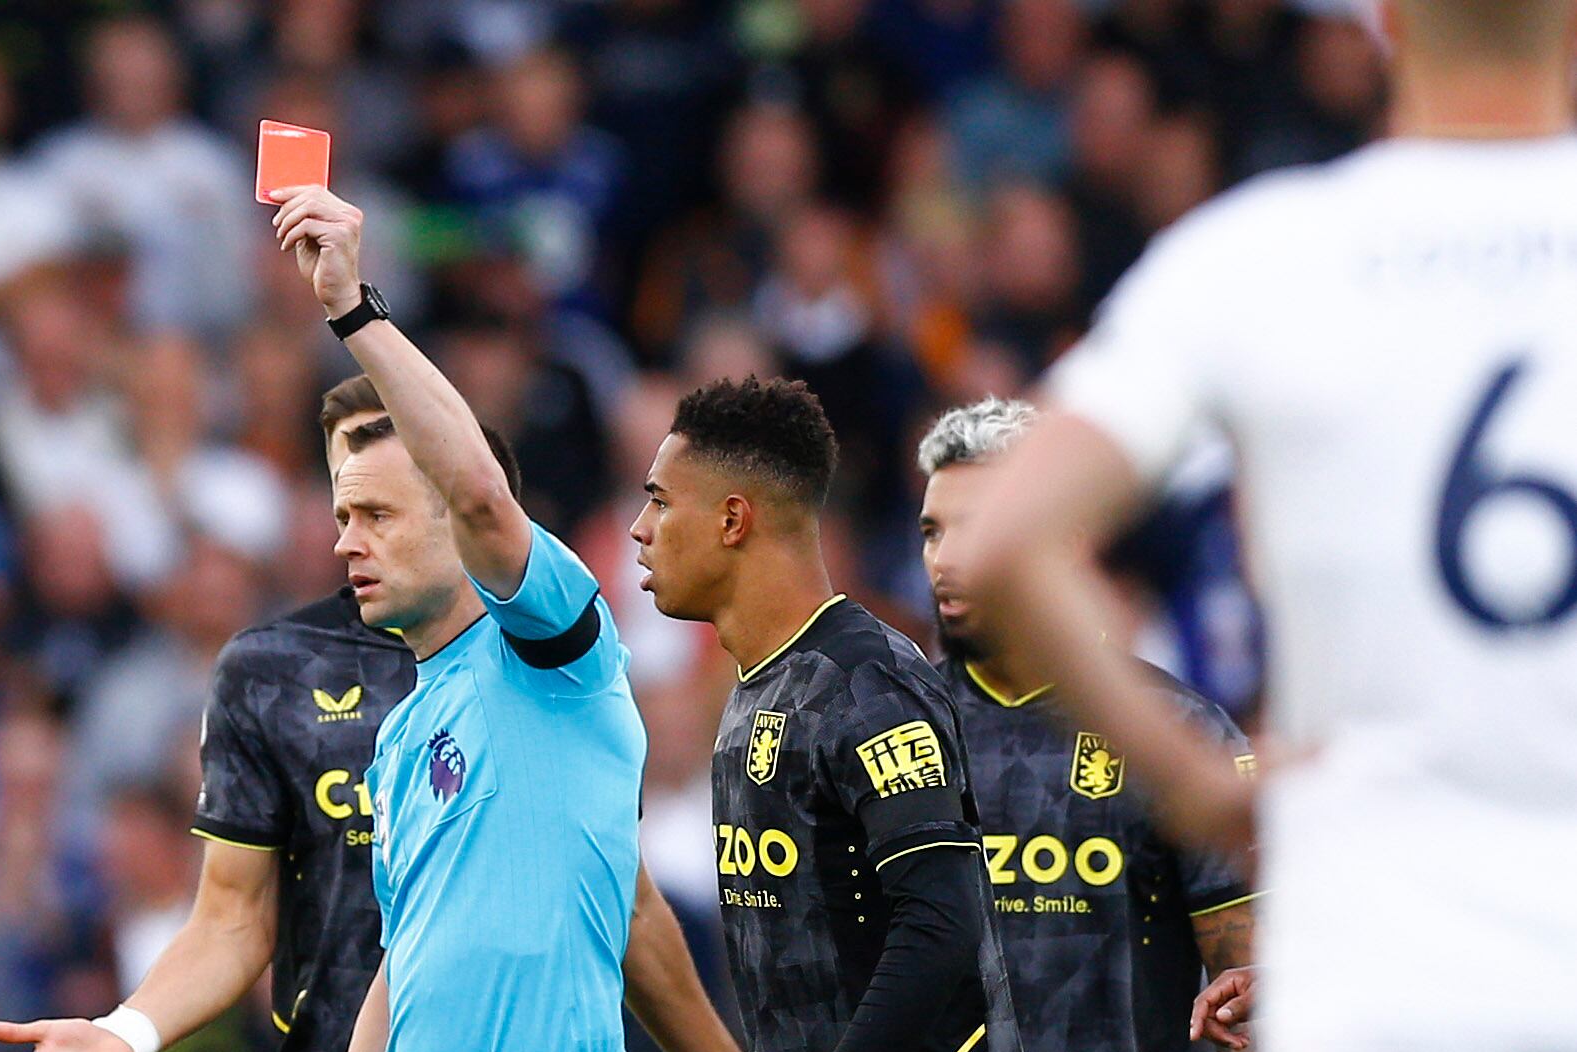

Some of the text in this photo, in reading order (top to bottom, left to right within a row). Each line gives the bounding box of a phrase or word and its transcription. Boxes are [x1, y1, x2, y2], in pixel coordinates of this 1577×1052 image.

[1434, 352, 1577, 634] 6
[713, 824, 798, 877] ZOO
[982, 835, 1123, 886] ZOO
[994, 895, 1091, 913] rive. Smile.
